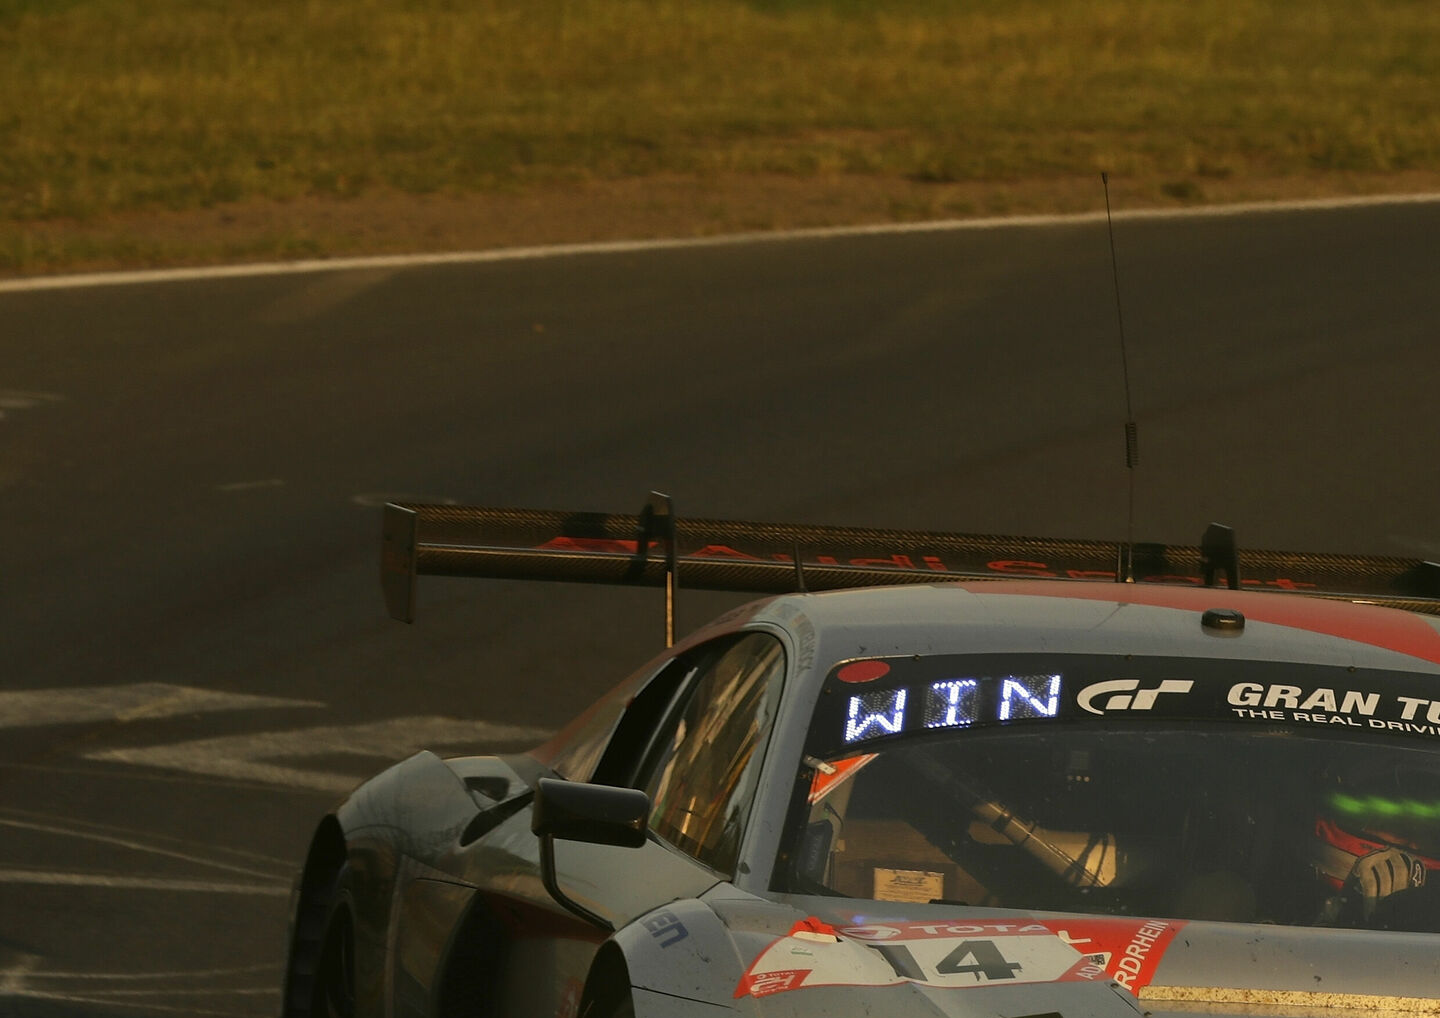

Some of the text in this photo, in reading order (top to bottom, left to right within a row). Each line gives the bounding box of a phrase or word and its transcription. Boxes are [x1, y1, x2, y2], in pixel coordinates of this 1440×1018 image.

[843, 673, 1062, 744] WIN
[1227, 682, 1381, 716] GRAN
[1232, 708, 1286, 721] THE
[1292, 711, 1362, 727] REAL
[866, 940, 1022, 982] 14
